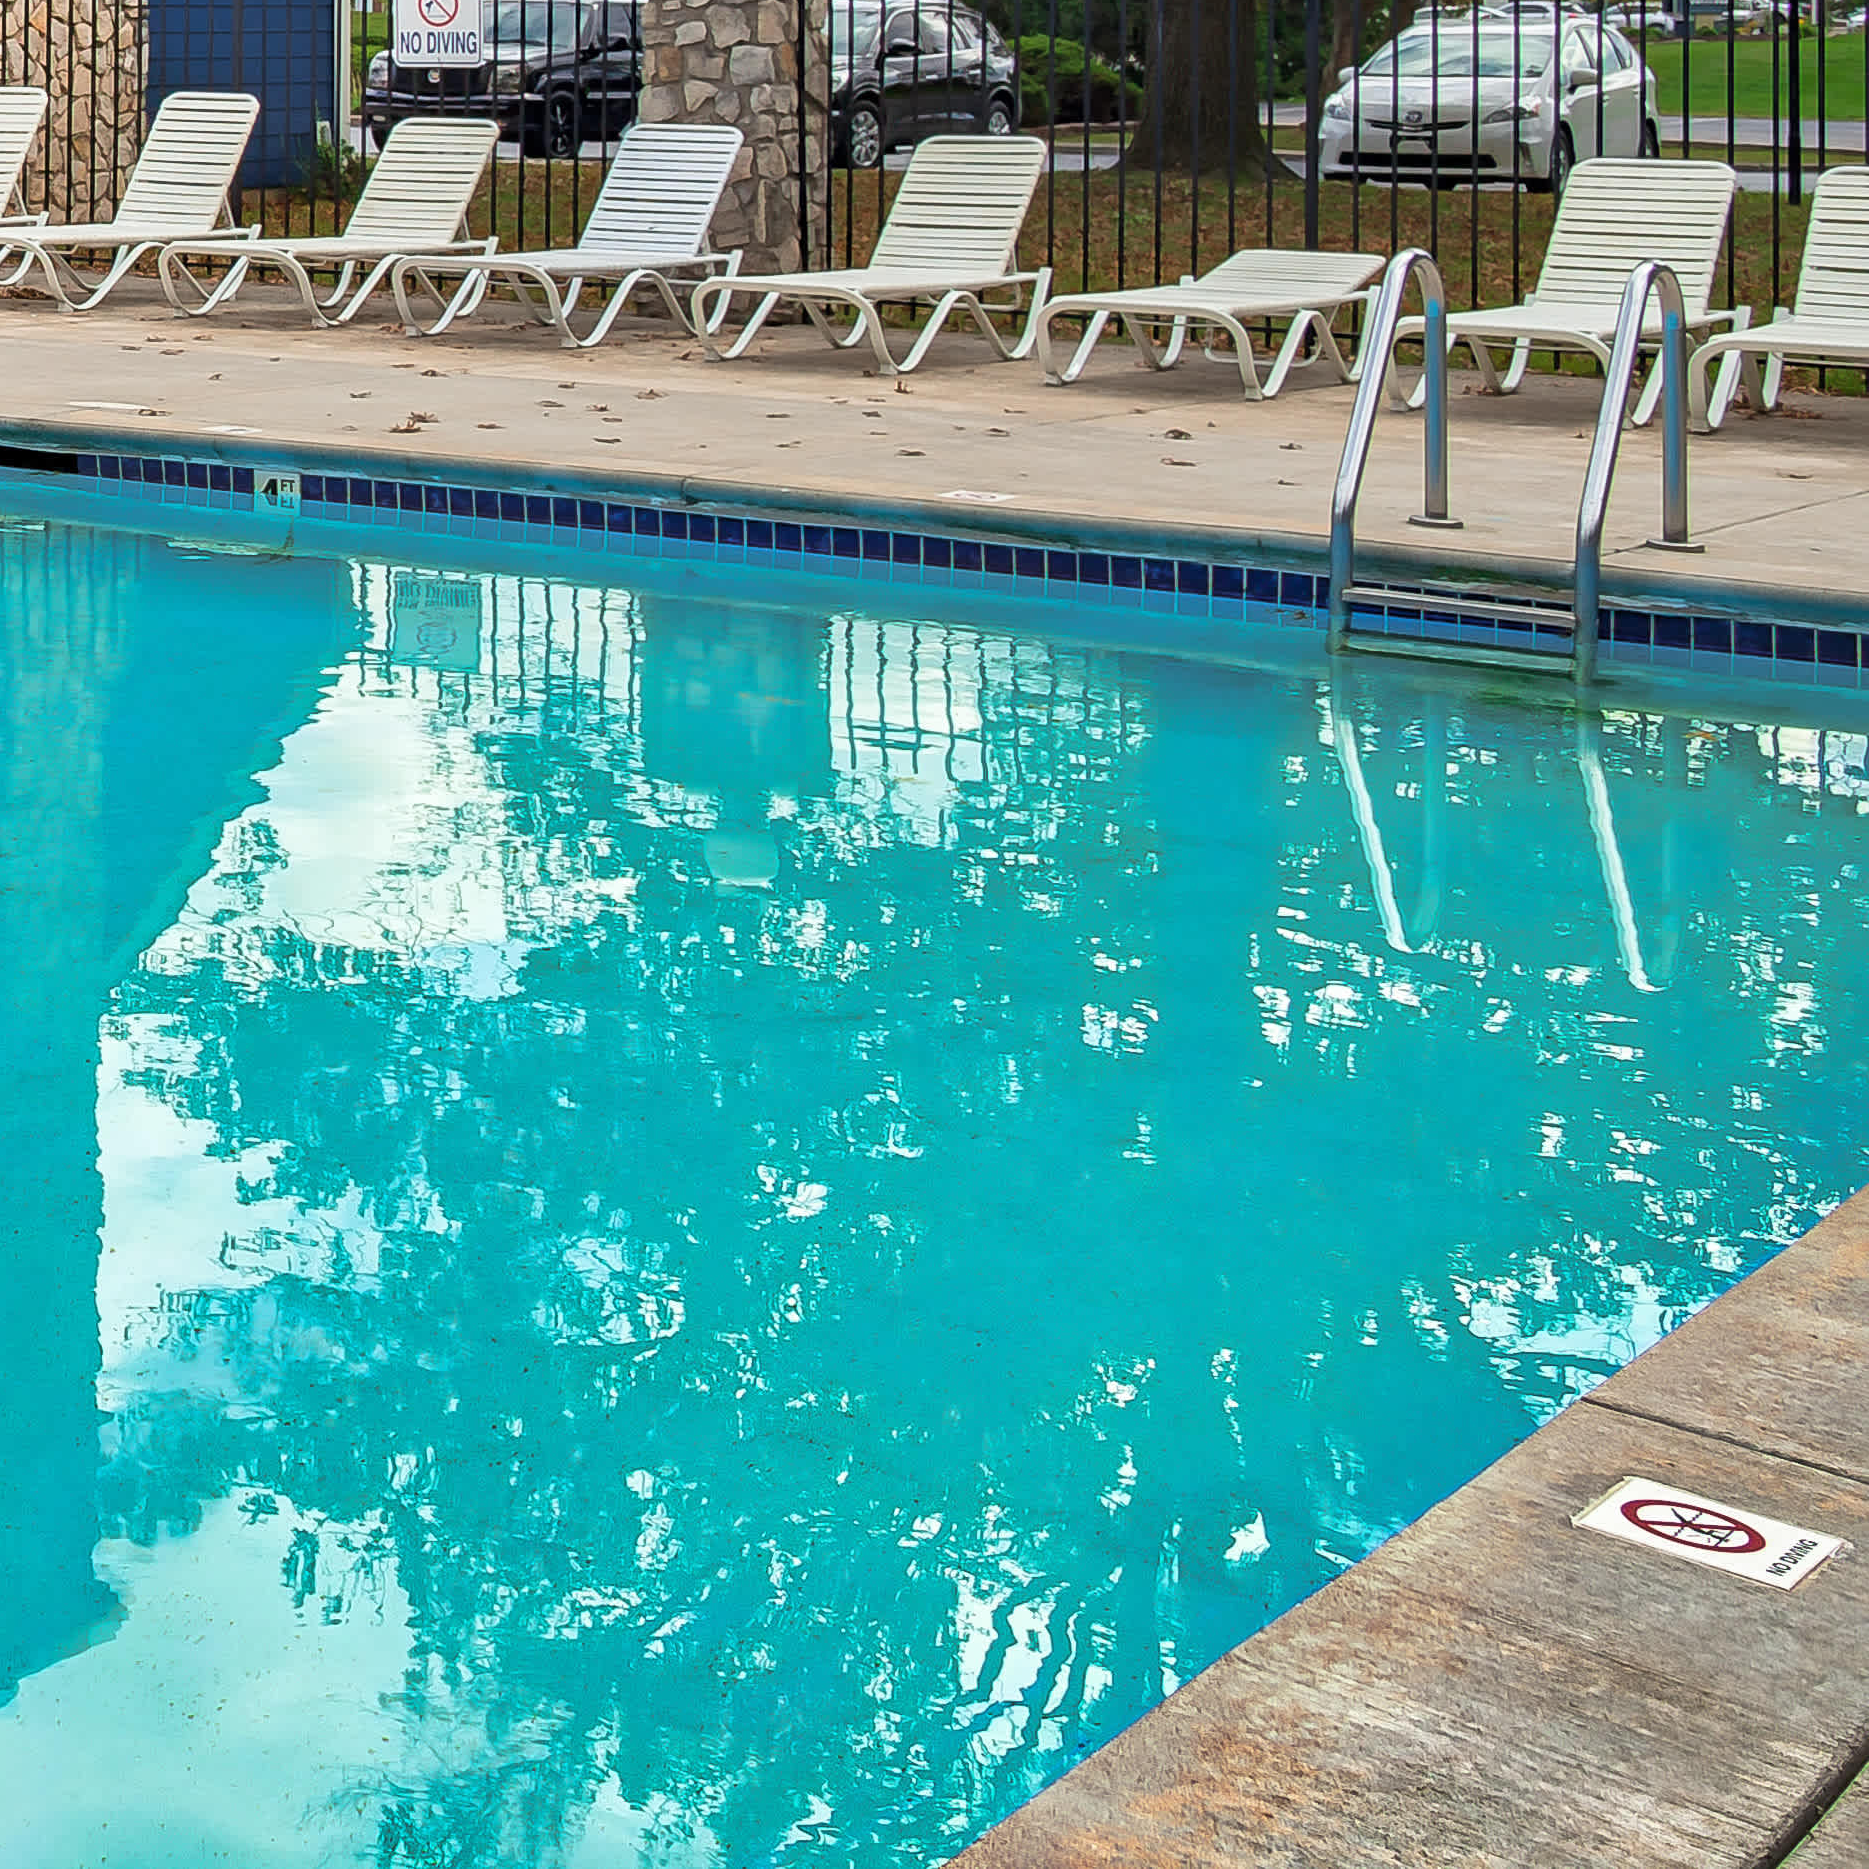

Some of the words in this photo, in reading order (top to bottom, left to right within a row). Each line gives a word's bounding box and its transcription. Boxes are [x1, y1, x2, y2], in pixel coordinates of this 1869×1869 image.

[400, 31, 422, 54] NO
[427, 31, 477, 54] DIVING
[261, 478, 278, 499] 4
[280, 479, 295, 493] FT
[1765, 1562, 1791, 1577] NO
[1779, 1539, 1818, 1564] DIVING
